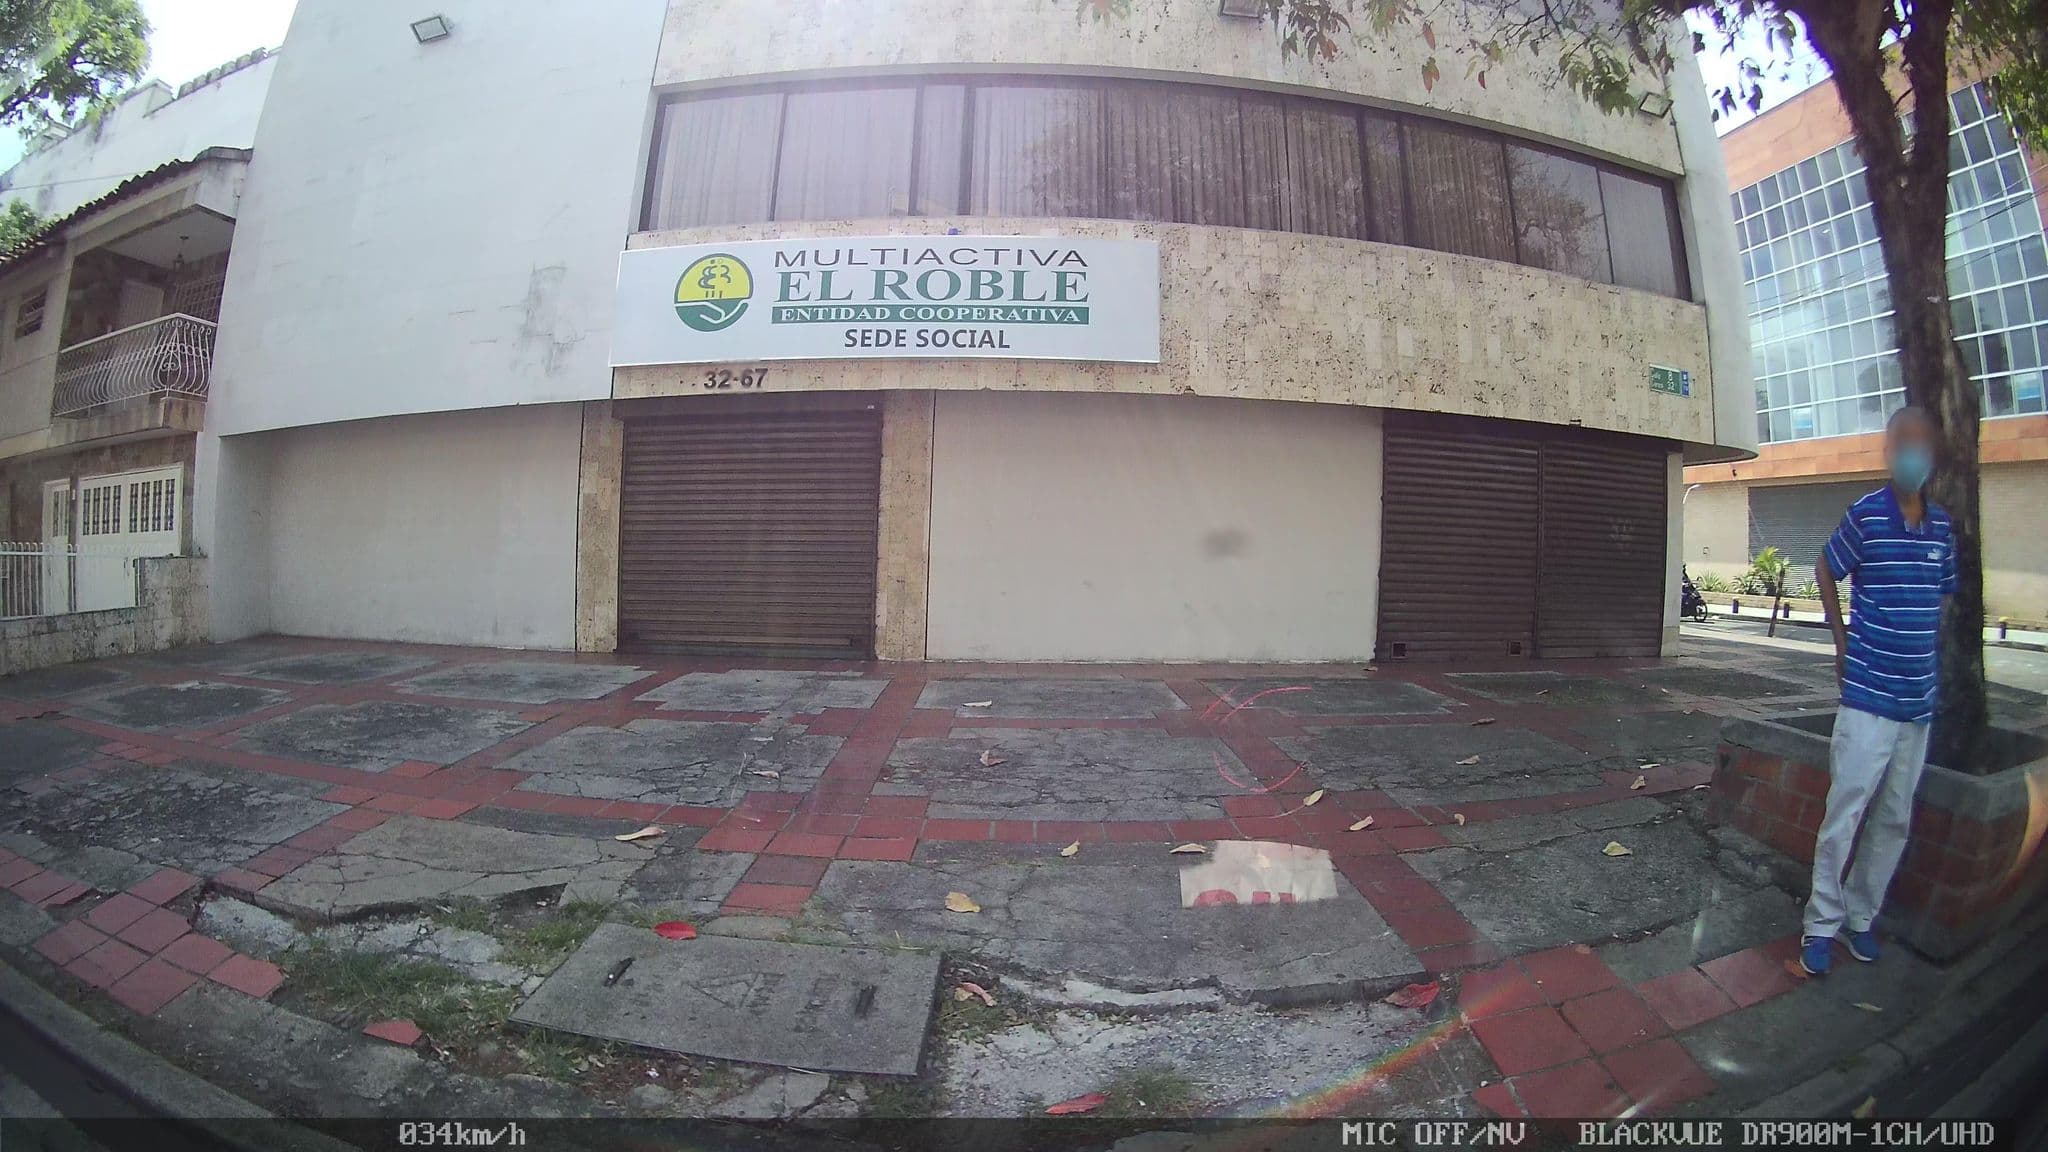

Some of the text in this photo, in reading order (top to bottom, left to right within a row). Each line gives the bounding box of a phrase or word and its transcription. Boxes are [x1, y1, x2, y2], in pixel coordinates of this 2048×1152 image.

[774, 248, 1088, 268] MULTIACTIVA
[773, 269, 1090, 303] EL ROBLE
[780, 306, 1081, 323] ENTIDAD COOPERATIVA
[844, 329, 1011, 349] SEDE SOCIAL
[704, 368, 768, 388] 32-67
